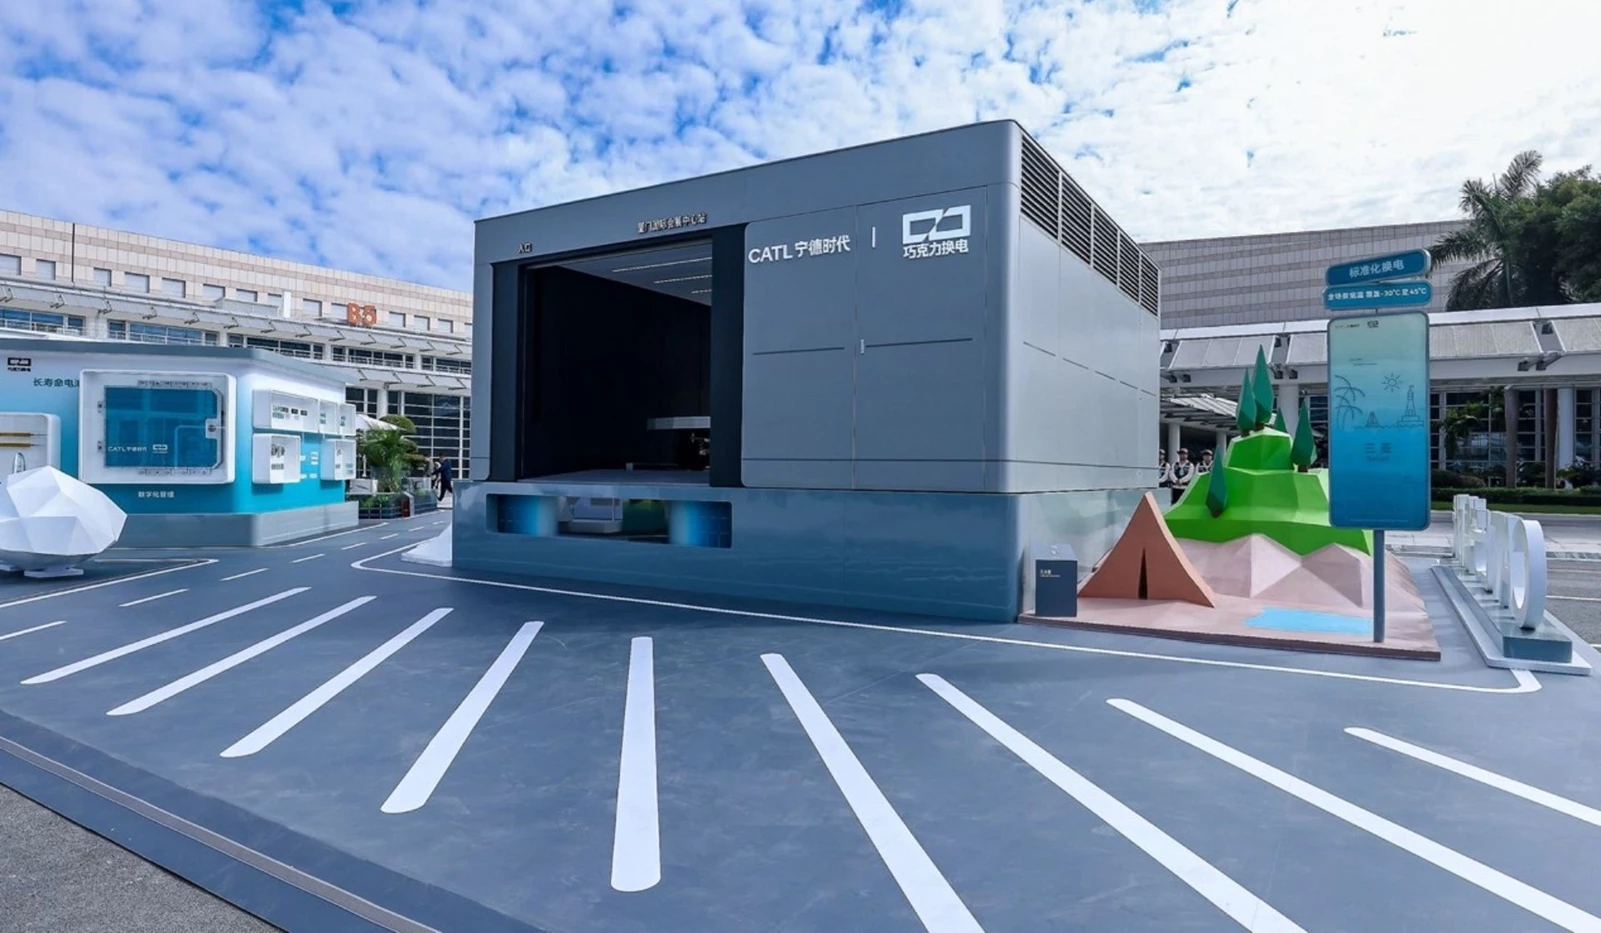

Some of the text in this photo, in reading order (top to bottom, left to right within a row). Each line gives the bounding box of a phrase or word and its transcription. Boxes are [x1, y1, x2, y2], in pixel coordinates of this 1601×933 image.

[517, 242, 532, 254] 入口
[748, 234, 851, 264] CATL 宁德时代
[903, 239, 970, 259] 巧克力换电
[1348, 259, 1406, 278] 标准化换电
[347, 302, 377, 326] B5
